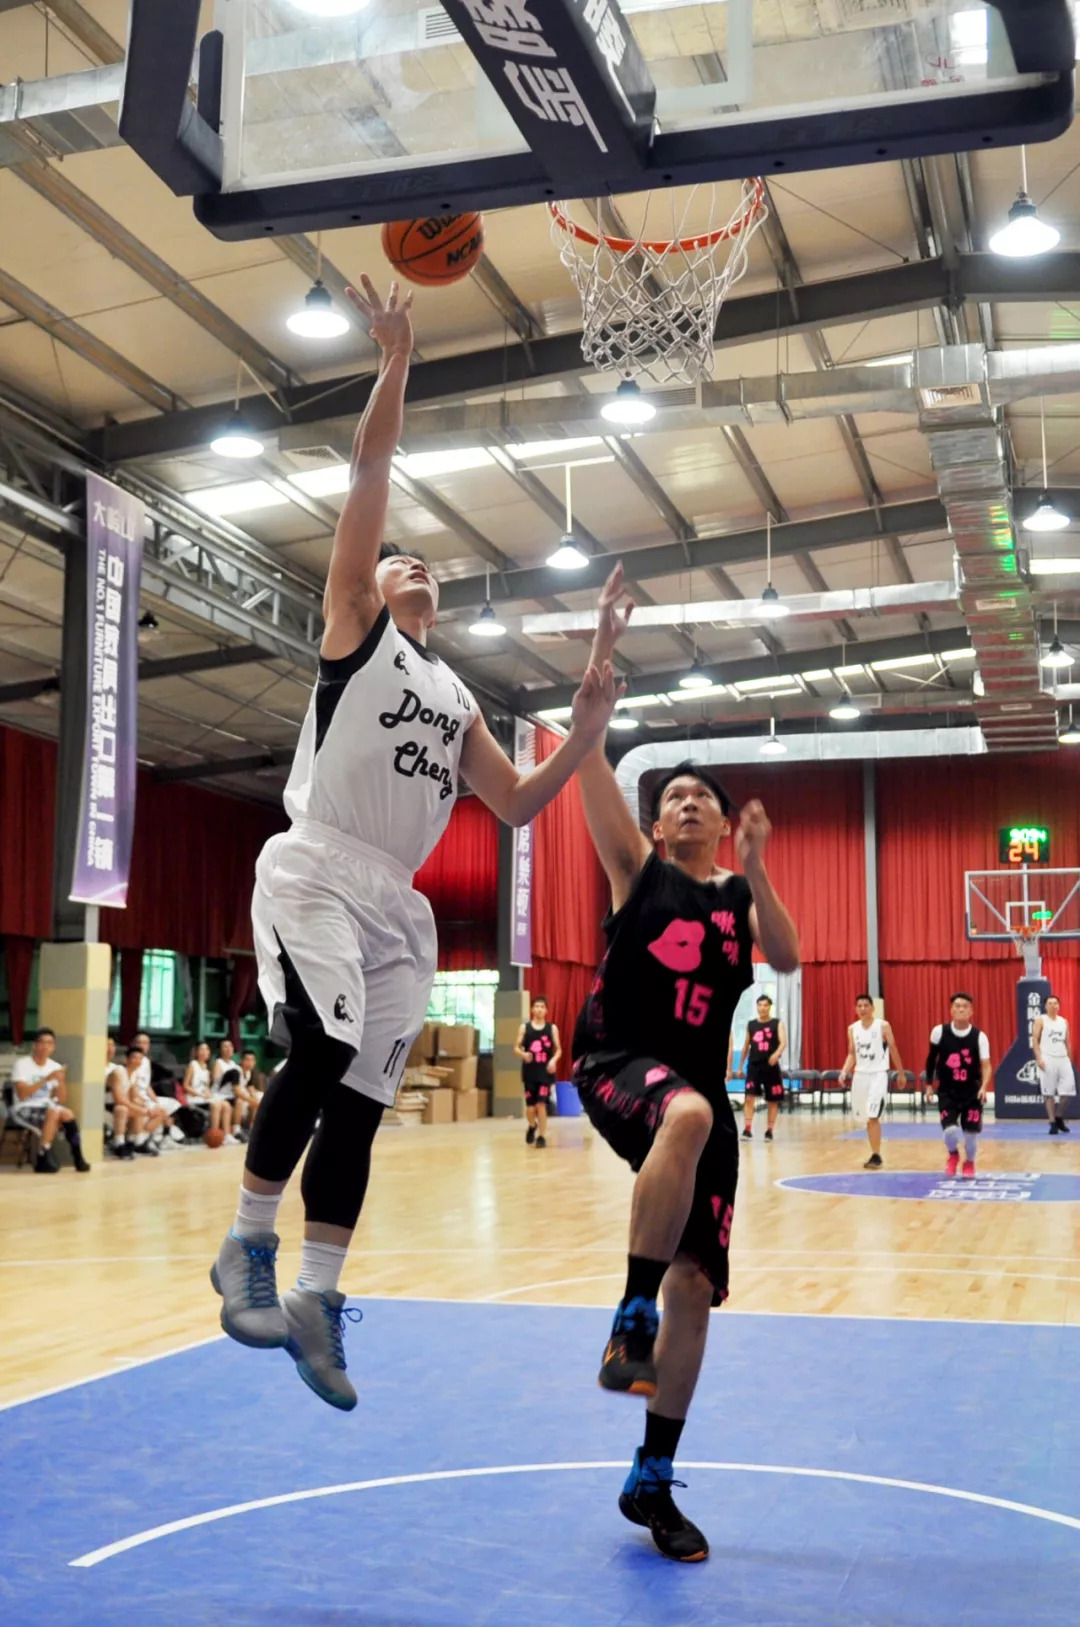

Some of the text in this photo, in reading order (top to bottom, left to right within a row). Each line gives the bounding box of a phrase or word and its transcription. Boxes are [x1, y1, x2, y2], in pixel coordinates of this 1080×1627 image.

[97, 549, 106, 574] THE
[92, 614, 105, 691] FURNITURE
[91, 695, 102, 750] EXPORT
[379, 688, 460, 747] Dong
[394, 741, 453, 800] Cheng
[1009, 841, 1039, 862] 24
[673, 978, 713, 1027] 15
